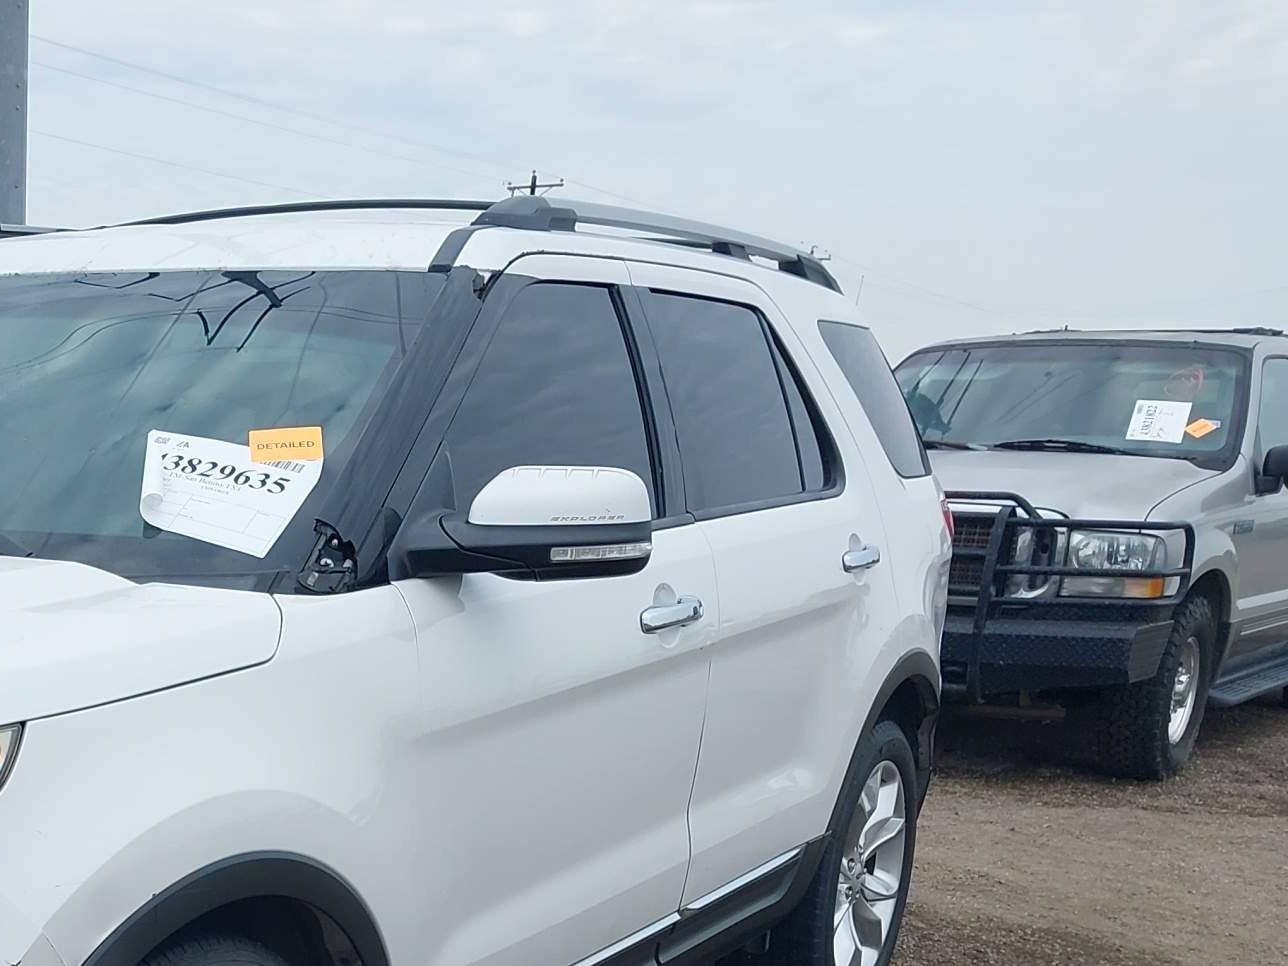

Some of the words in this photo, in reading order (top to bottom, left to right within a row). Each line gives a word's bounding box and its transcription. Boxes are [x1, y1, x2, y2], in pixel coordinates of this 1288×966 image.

[257, 440, 315, 450] DETAILED
[161, 453, 291, 494] 3829635
[550, 514, 625, 522] EXPLORER
